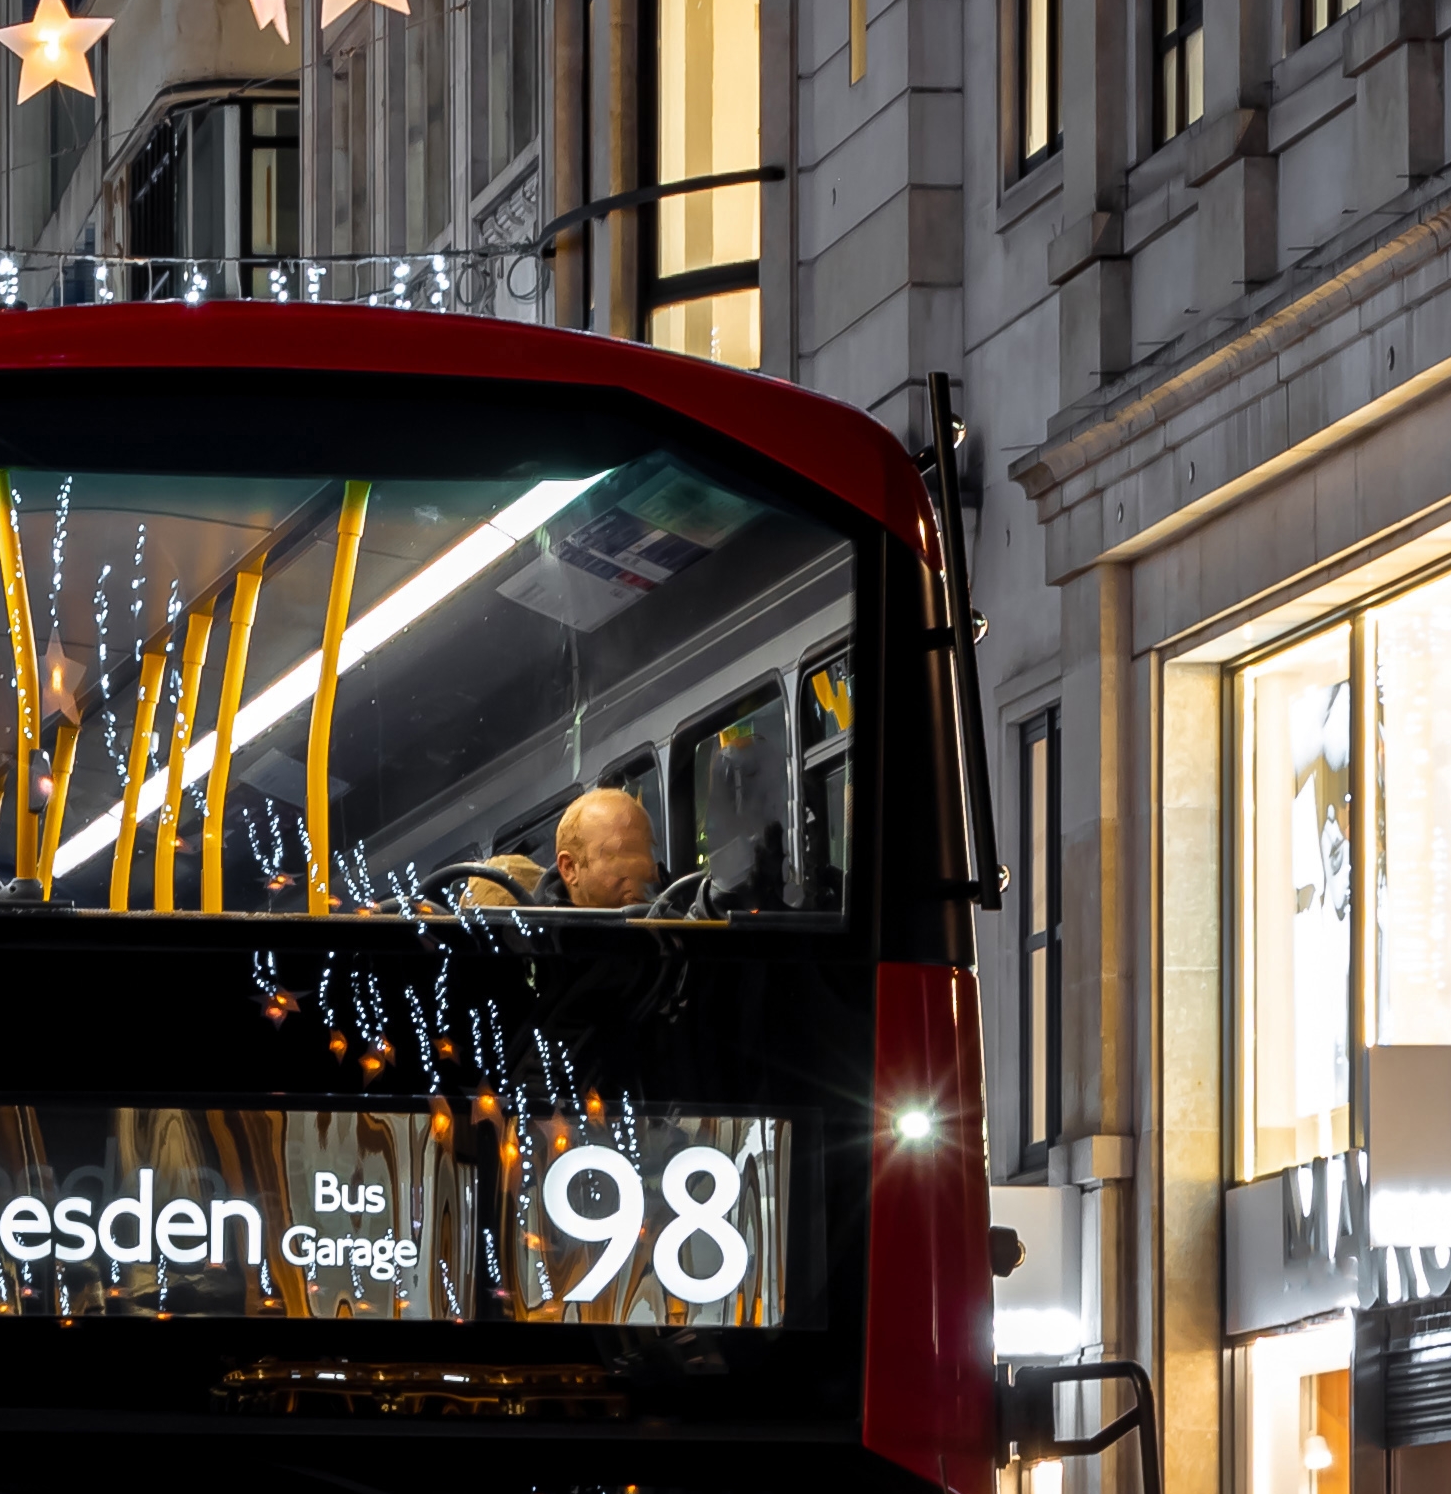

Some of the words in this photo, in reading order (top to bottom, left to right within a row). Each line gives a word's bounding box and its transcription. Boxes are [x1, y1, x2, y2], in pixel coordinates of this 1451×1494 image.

[314, 1170, 387, 1215] Bus
[542, 1144, 750, 1304] 98
[281, 1226, 419, 1282] Garage
